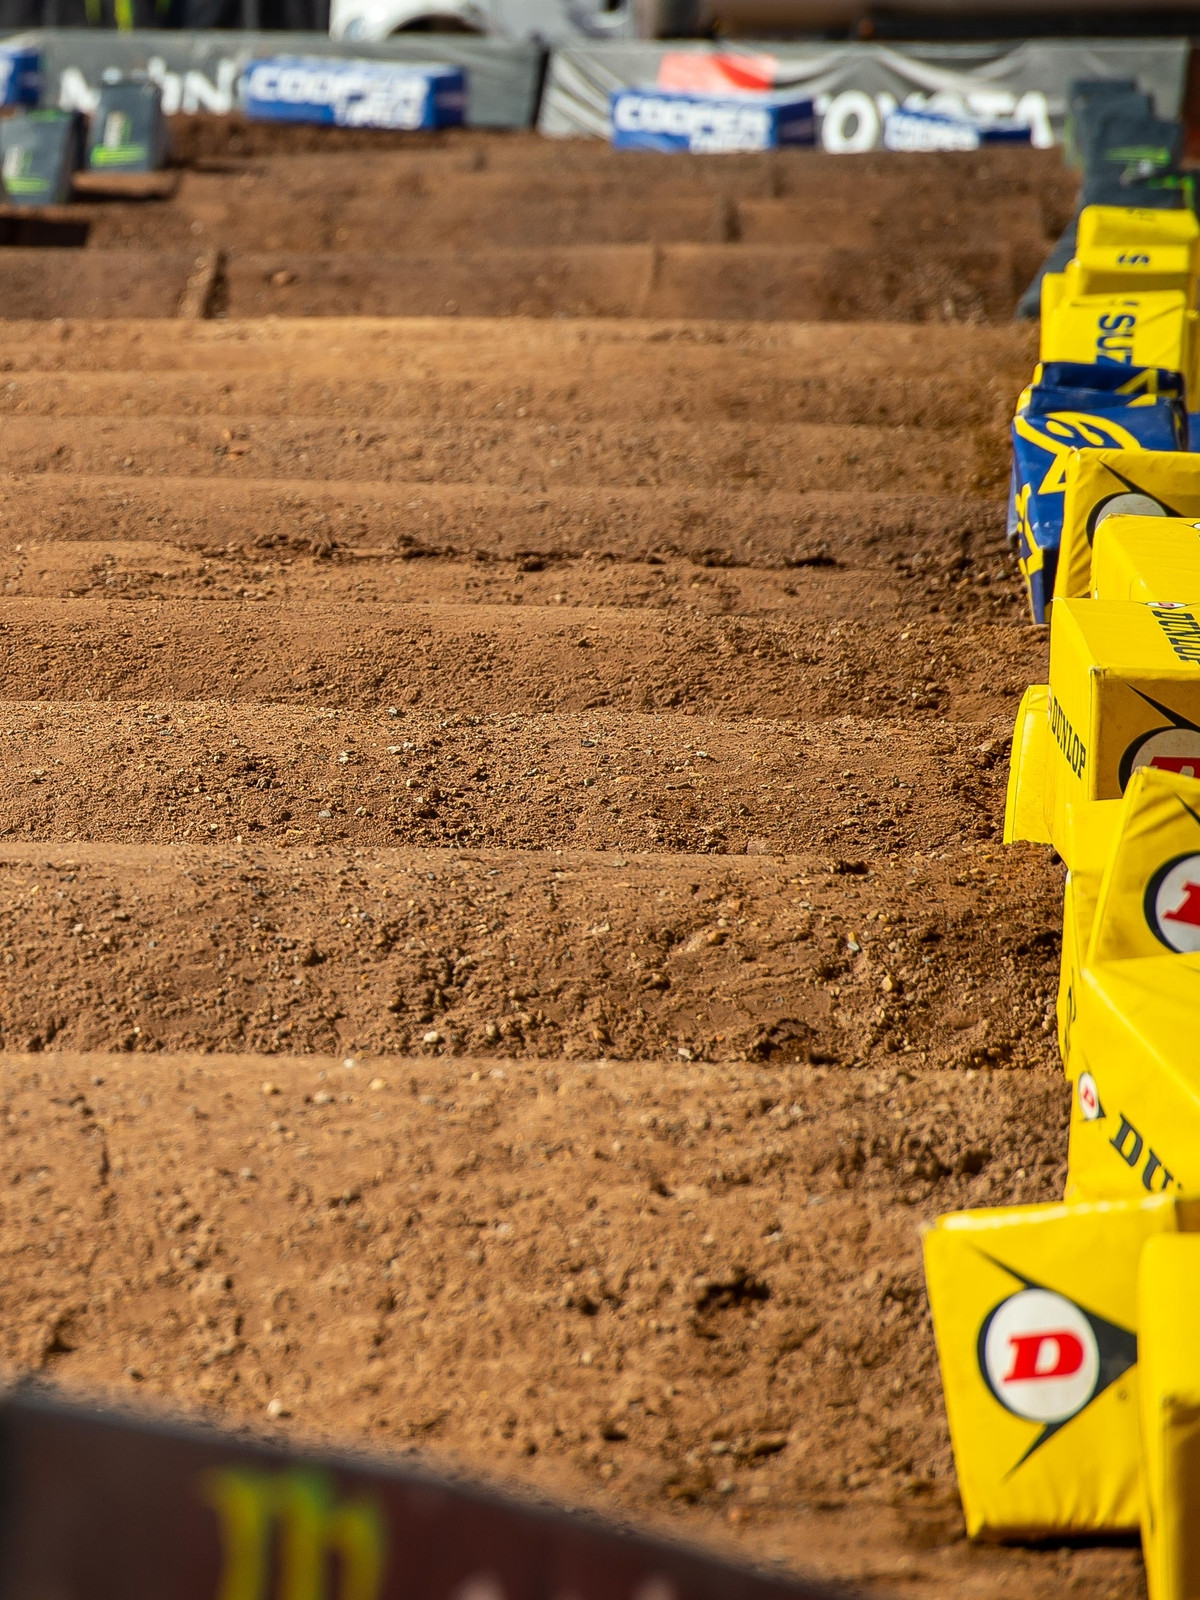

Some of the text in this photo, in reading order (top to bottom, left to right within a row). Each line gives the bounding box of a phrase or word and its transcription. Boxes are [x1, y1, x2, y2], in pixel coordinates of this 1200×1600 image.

[1050, 695, 1087, 781] DUNLOP
[1108, 1111, 1184, 1193] DU
[1001, 1328, 1086, 1384] D
